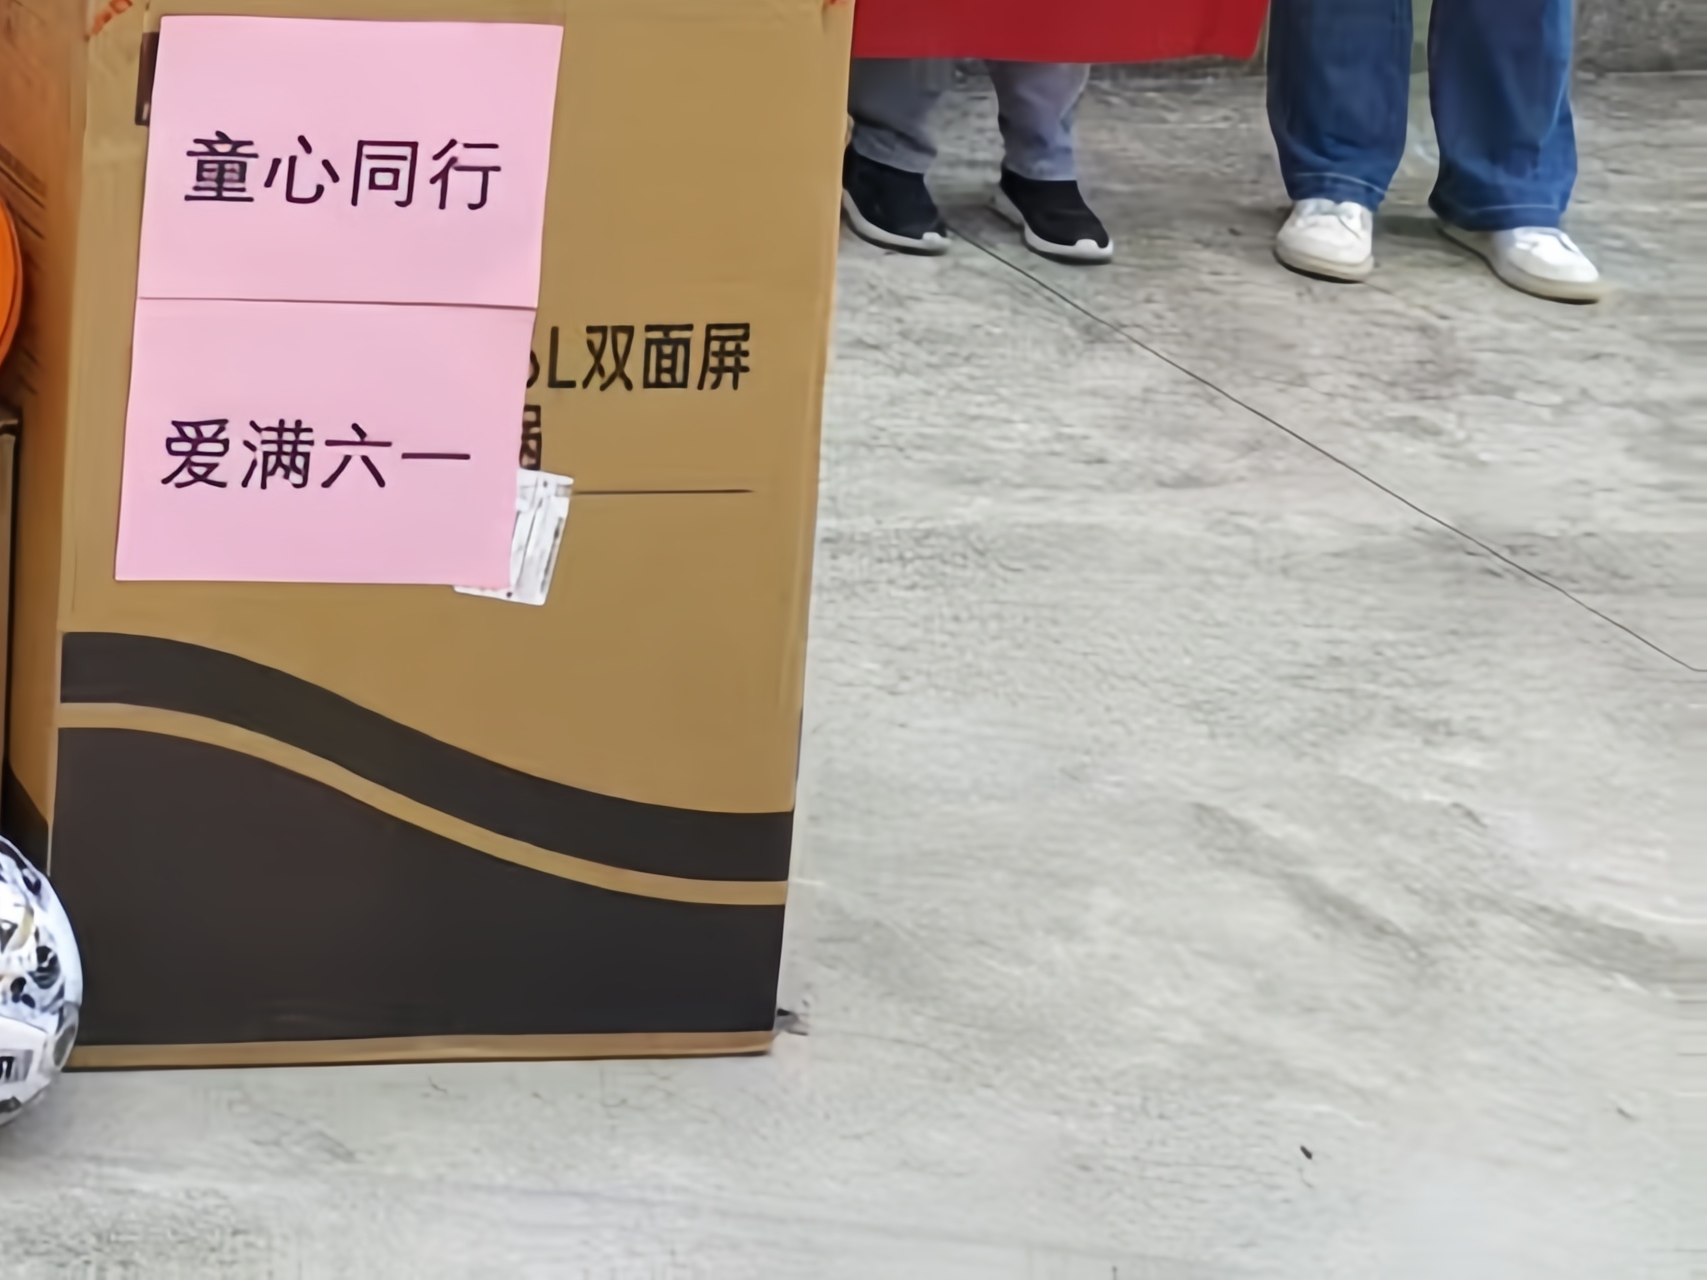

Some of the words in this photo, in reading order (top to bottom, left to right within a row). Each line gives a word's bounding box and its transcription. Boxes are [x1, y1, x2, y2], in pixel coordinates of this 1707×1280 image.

[184, 130, 503, 212] 童心同行
[160, 417, 472, 491] 爱满六一
